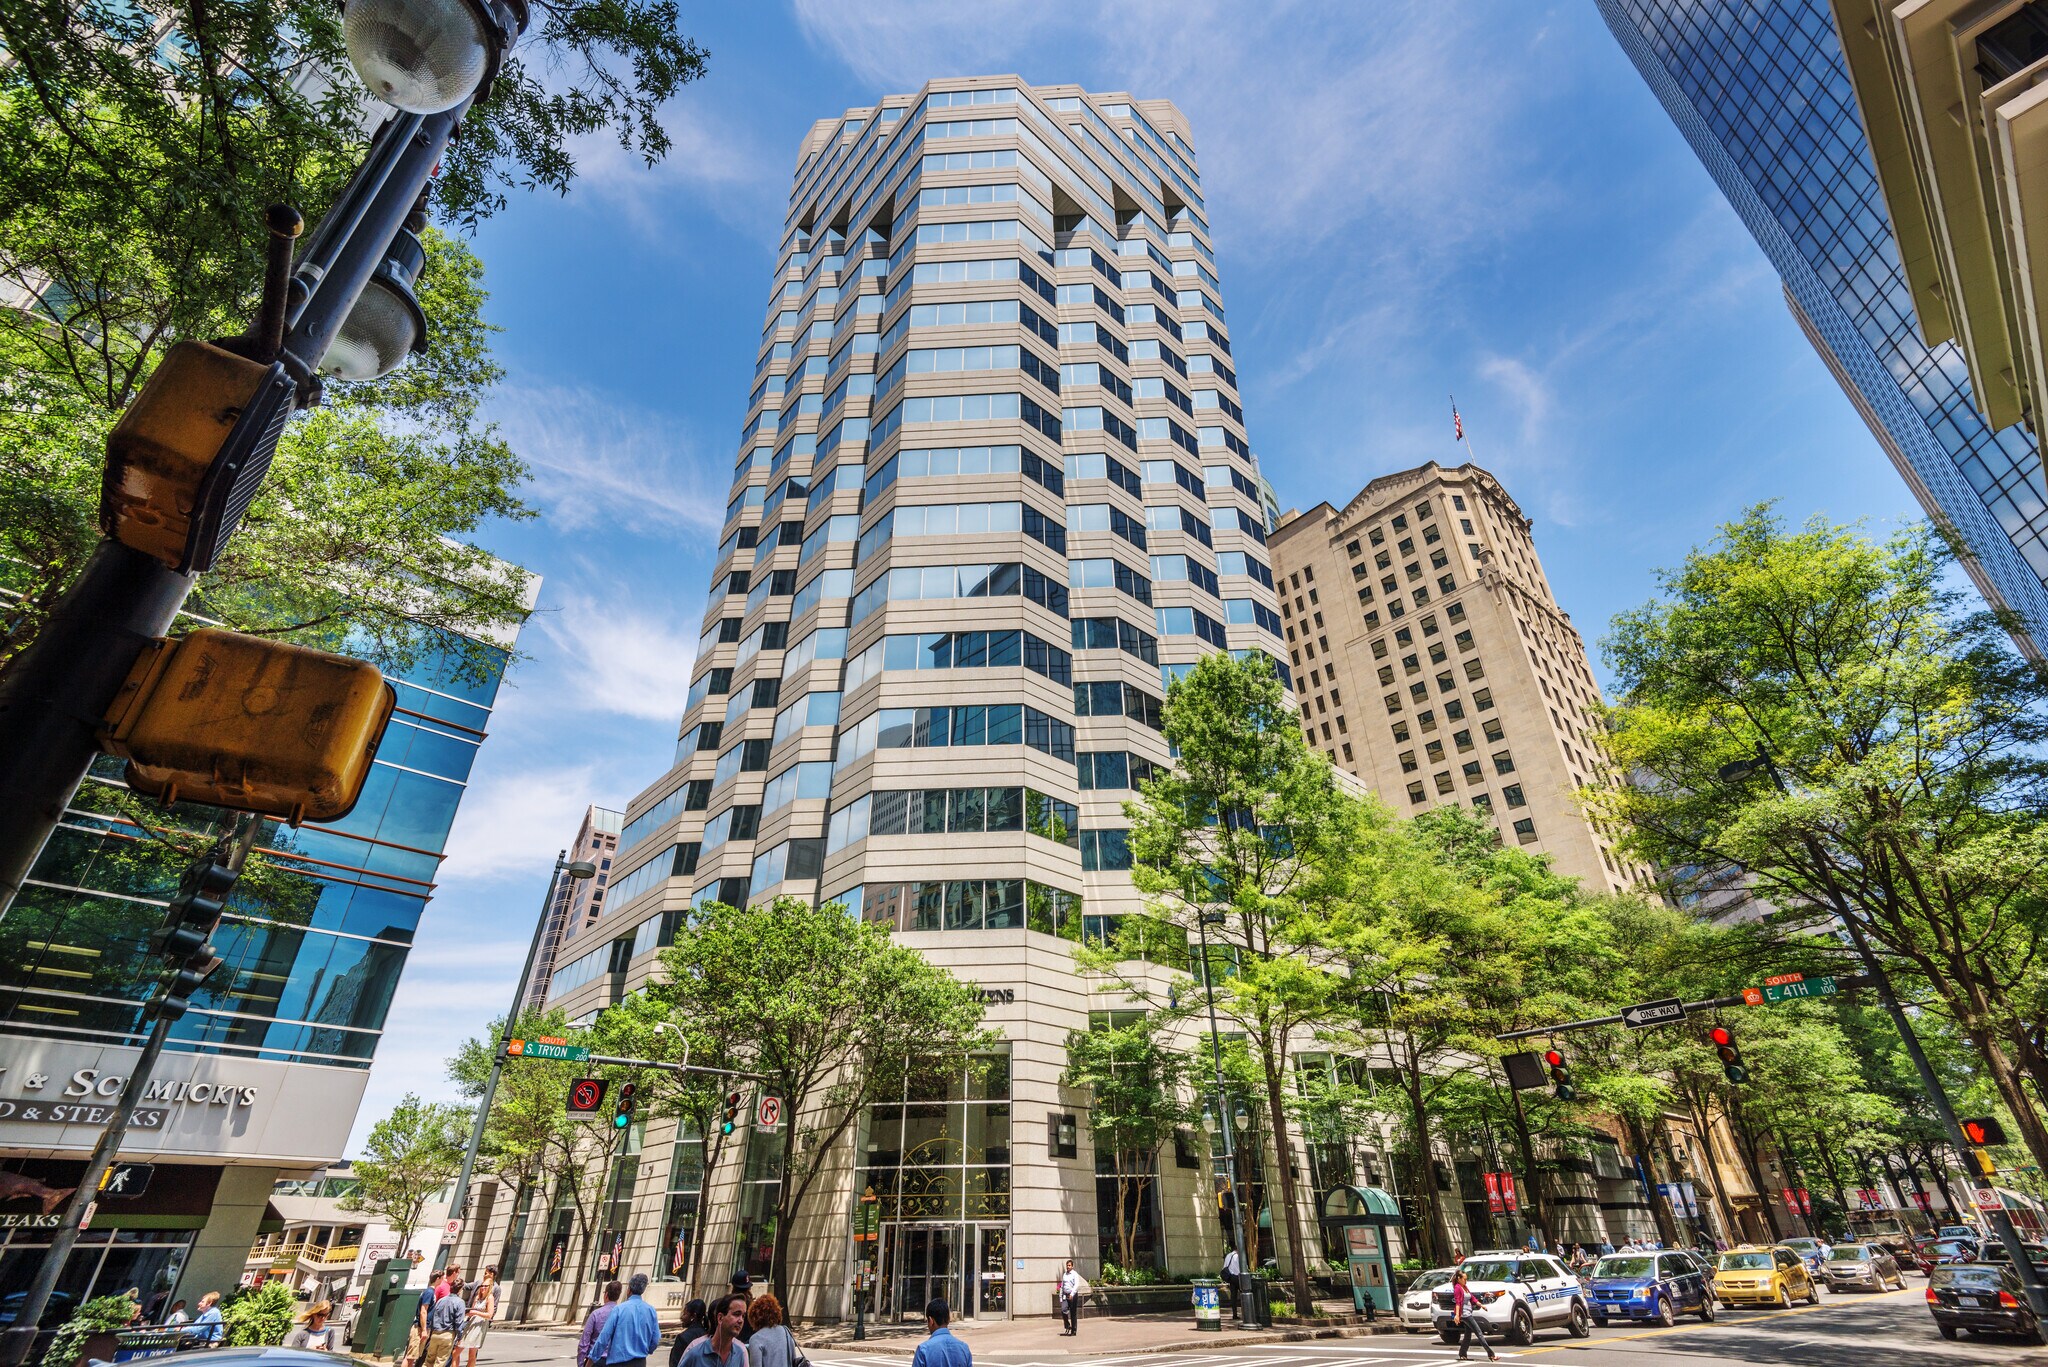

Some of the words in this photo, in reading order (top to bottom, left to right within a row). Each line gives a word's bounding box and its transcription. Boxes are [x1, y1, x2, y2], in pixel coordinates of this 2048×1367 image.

[1766, 973, 1802, 985] SOUTH
[1766, 988, 1780, 1000] E.
[1783, 983, 1809, 997] 4TH
[1821, 976, 1833, 985] ST
[1820, 985, 1836, 994] 100
[1640, 1009, 1657, 1019] ONE
[1658, 1005, 1676, 1016] WAY
[540, 1036, 567, 1045] SOUTH
[526, 1043, 534, 1055] S.
[537, 1044, 568, 1058] TRYON
[581, 1047, 589, 1055] ST
[25, 1072, 49, 1089] &
[64, 1068, 258, 1106] SCMICK'S
[22, 1107, 43, 1120] &
[1535, 1293, 1560, 1301] POLICE
